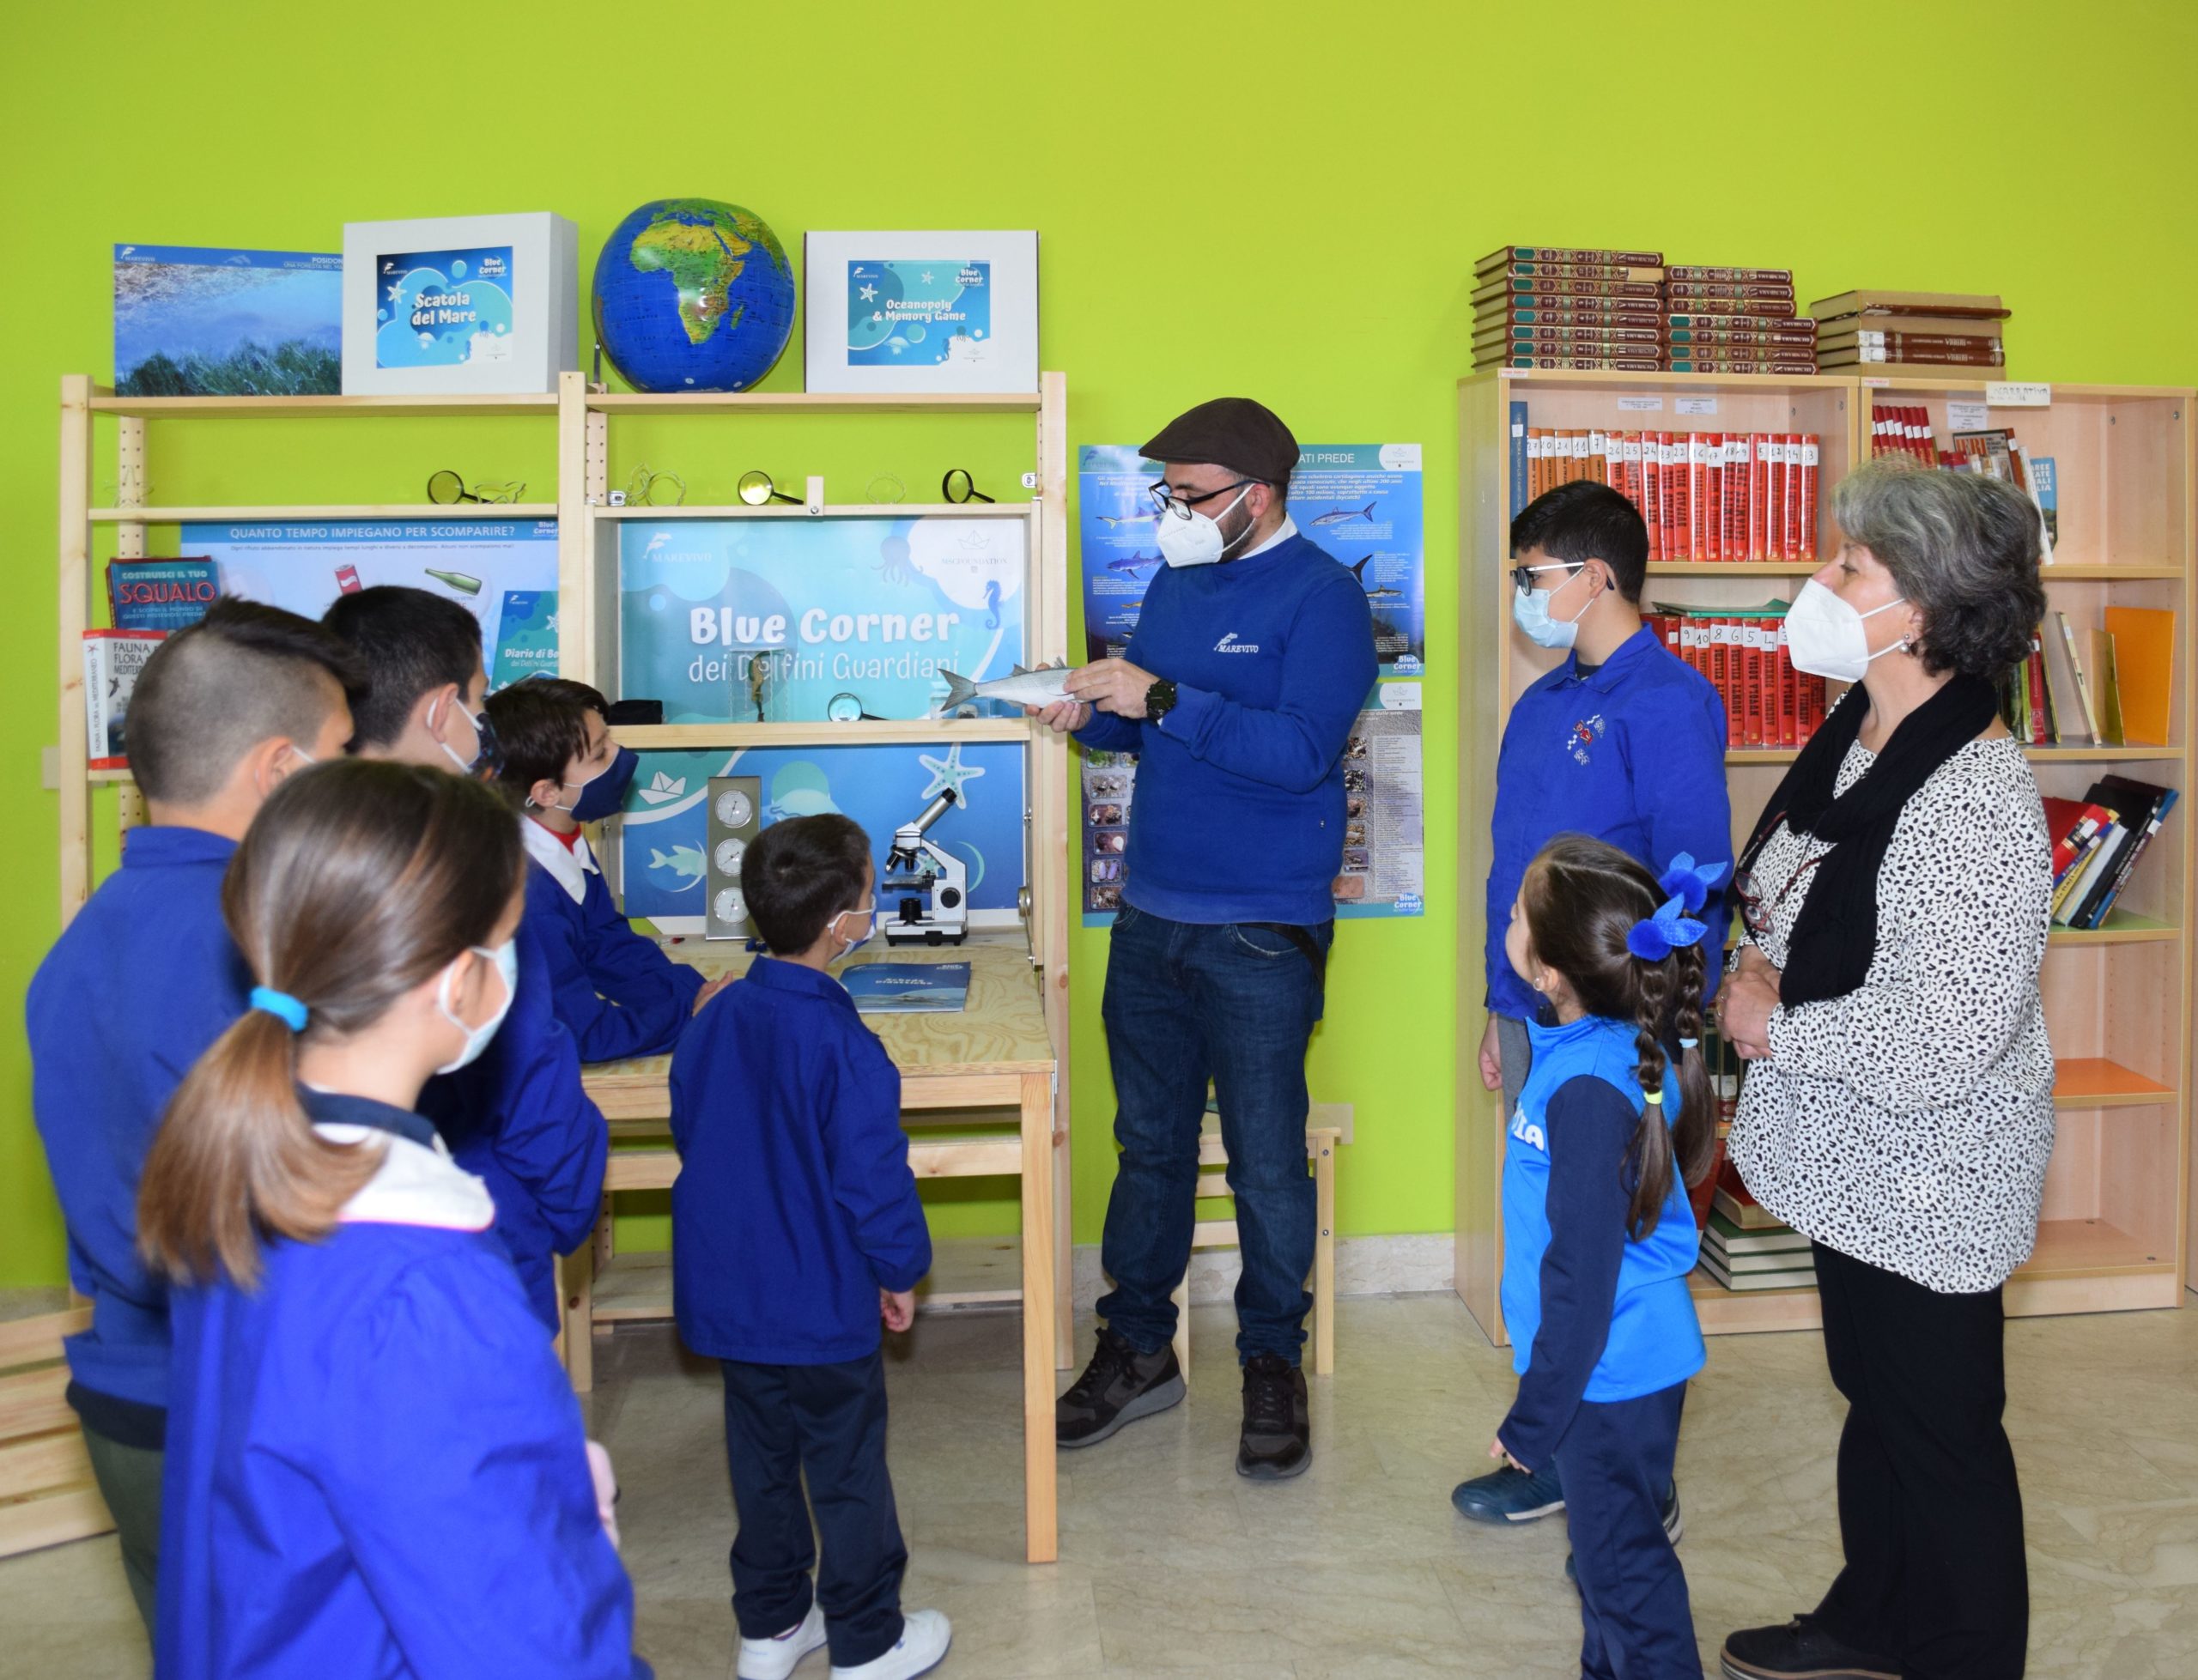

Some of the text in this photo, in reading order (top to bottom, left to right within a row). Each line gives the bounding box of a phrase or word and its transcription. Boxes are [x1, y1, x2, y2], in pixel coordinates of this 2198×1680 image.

[479, 266, 507, 275] Corner
[415, 292, 470, 308] Scatola
[886, 300, 952, 312] Oceanopoly
[412, 309, 477, 325] del Mare
[872, 312, 966, 323] & Memory Game
[1608, 446, 1620, 456] 26
[1626, 446, 1637, 455] 25
[1644, 446, 1656, 456] 24
[1674, 448, 1686, 457] 22
[1317, 453, 1355, 464] PREDE
[1647, 474, 1656, 505] CARSON
[1676, 469, 1687, 527] BUFFALO BILL
[1724, 491, 1734, 539] CALAMITY
[1736, 493, 1746, 541] CALAMITY
[230, 526, 515, 539] QUANTO TEMPO IMPIEGANO PER SCOMPARIRE?
[653, 552, 712, 563] MAREVIVO
[122, 571, 174, 579] COSTRUISCI
[119, 581, 216, 604] SQUALO
[689, 606, 961, 646] Blue Corner
[1685, 630, 1690, 640] 9
[1697, 634, 1709, 645] 10
[1715, 628, 1722, 640] 8
[1731, 629, 1739, 642] 6
[1748, 631, 1756, 643] 5
[113, 642, 151, 653] FAUNA
[505, 648, 534, 658] Diario
[536, 648, 546, 658] di
[1218, 645, 1260, 653] MAREVIVO
[113, 654, 144, 664] FLORA
[1715, 649, 1724, 680] KILLERS
[689, 650, 959, 683] dei Delfini Guardiani
[90, 658, 100, 701] MEDITERRANEO
[1731, 649, 1742, 714] BOUNTY KILLERS
[1748, 655, 1759, 716] NUVOLA ROSSA
[1782, 683, 1793, 716] NUVOLA
